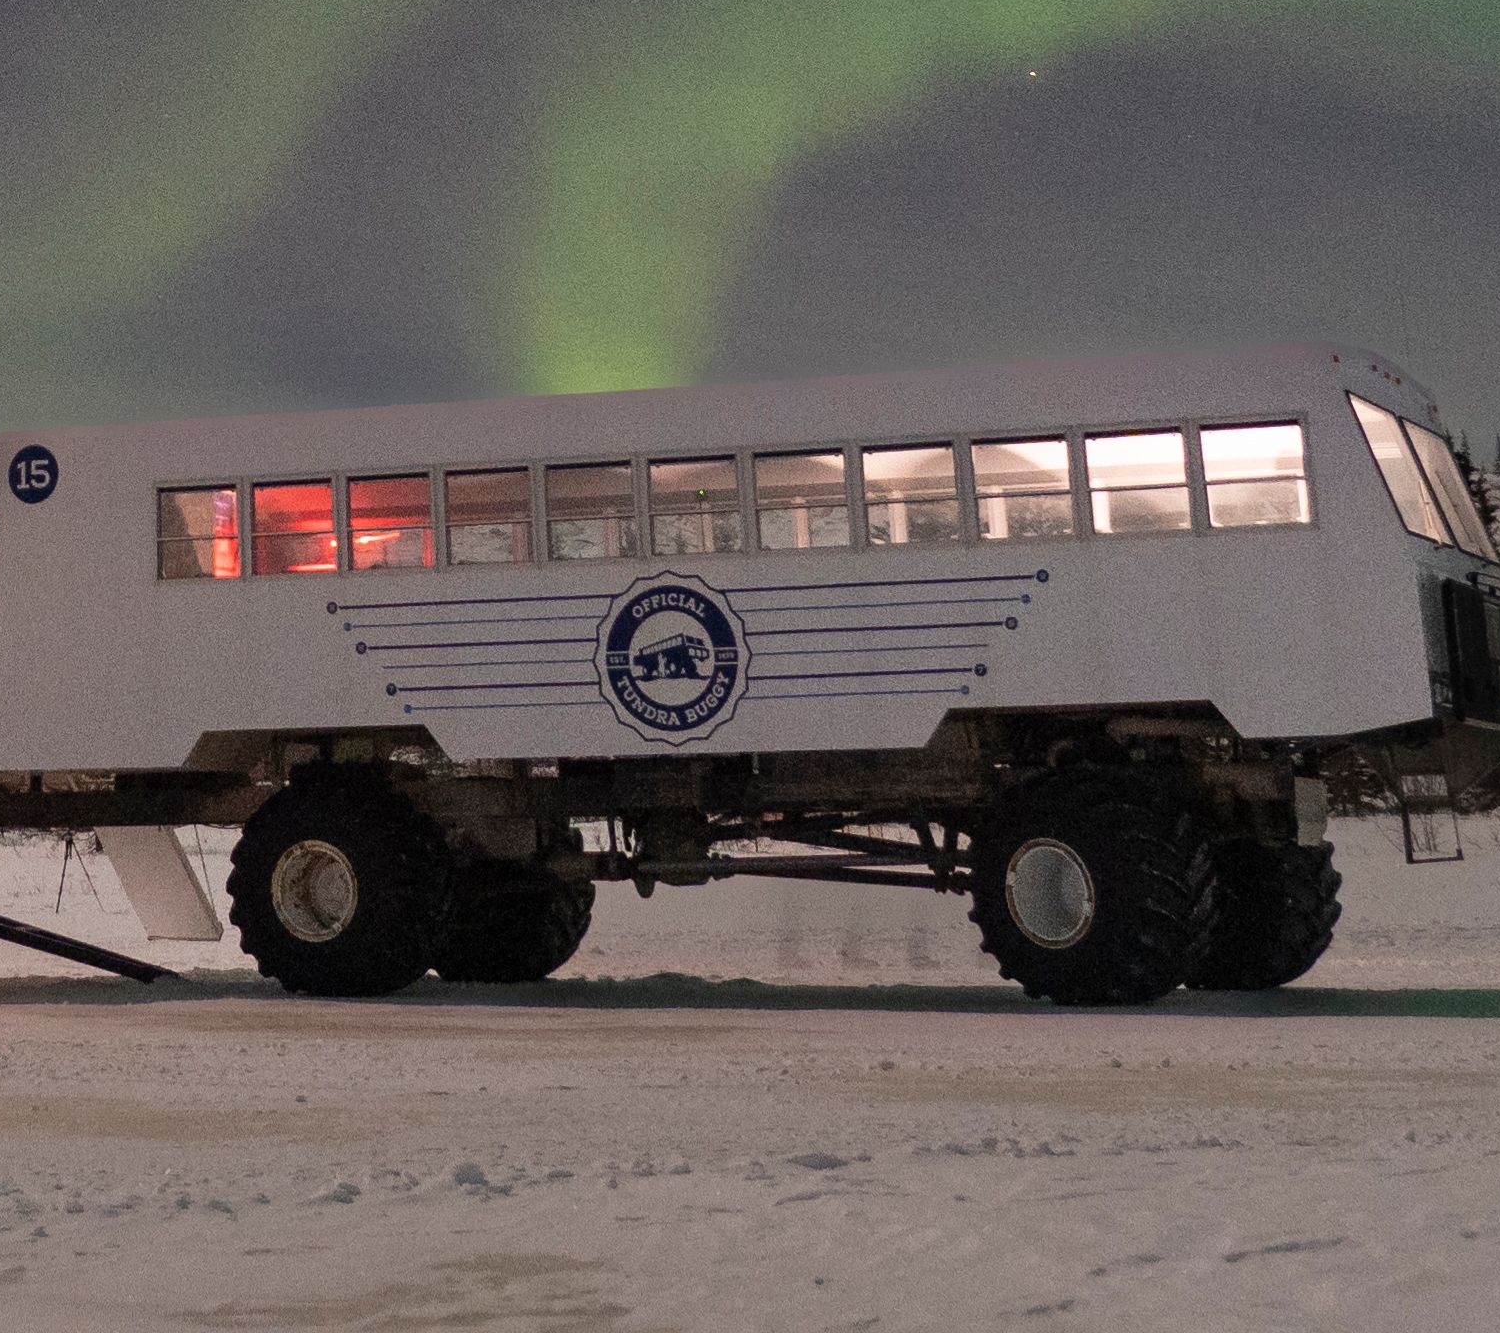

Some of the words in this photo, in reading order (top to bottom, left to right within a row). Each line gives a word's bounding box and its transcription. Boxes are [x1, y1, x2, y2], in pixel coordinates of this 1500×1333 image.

[16, 459, 50, 489] 15
[632, 593, 704, 617] OFFICIAL
[617, 676, 680, 725] TUNDRA
[685, 672, 729, 723] BUGGY
